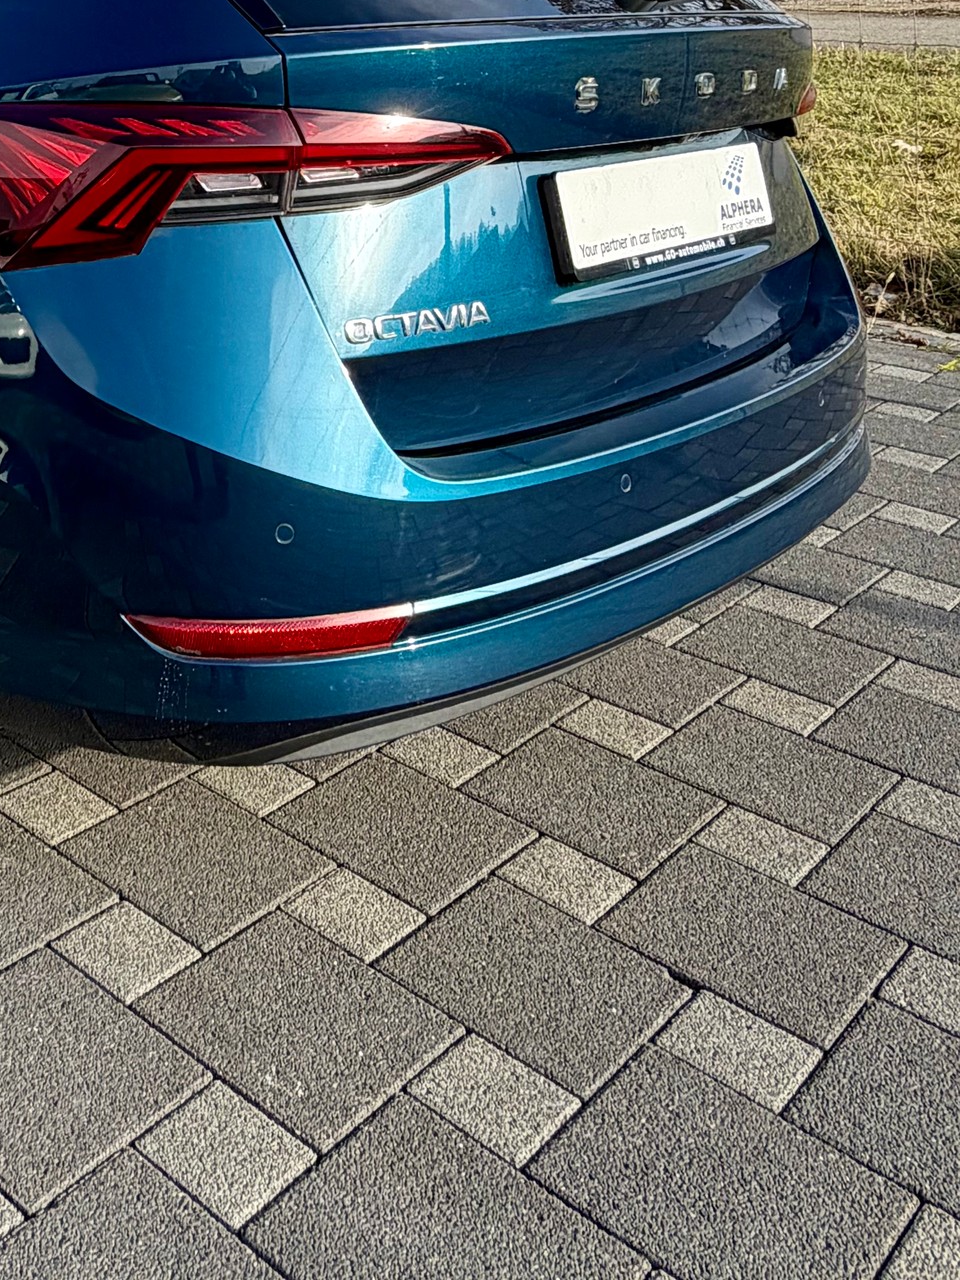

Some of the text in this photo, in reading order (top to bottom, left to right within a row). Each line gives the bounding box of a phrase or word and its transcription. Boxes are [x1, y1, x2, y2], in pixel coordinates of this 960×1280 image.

[720, 197, 764, 221] ALPHERA
[579, 224, 687, 259] Your partner in car financing.
[344, 300, 491, 345] OCTAVIA
